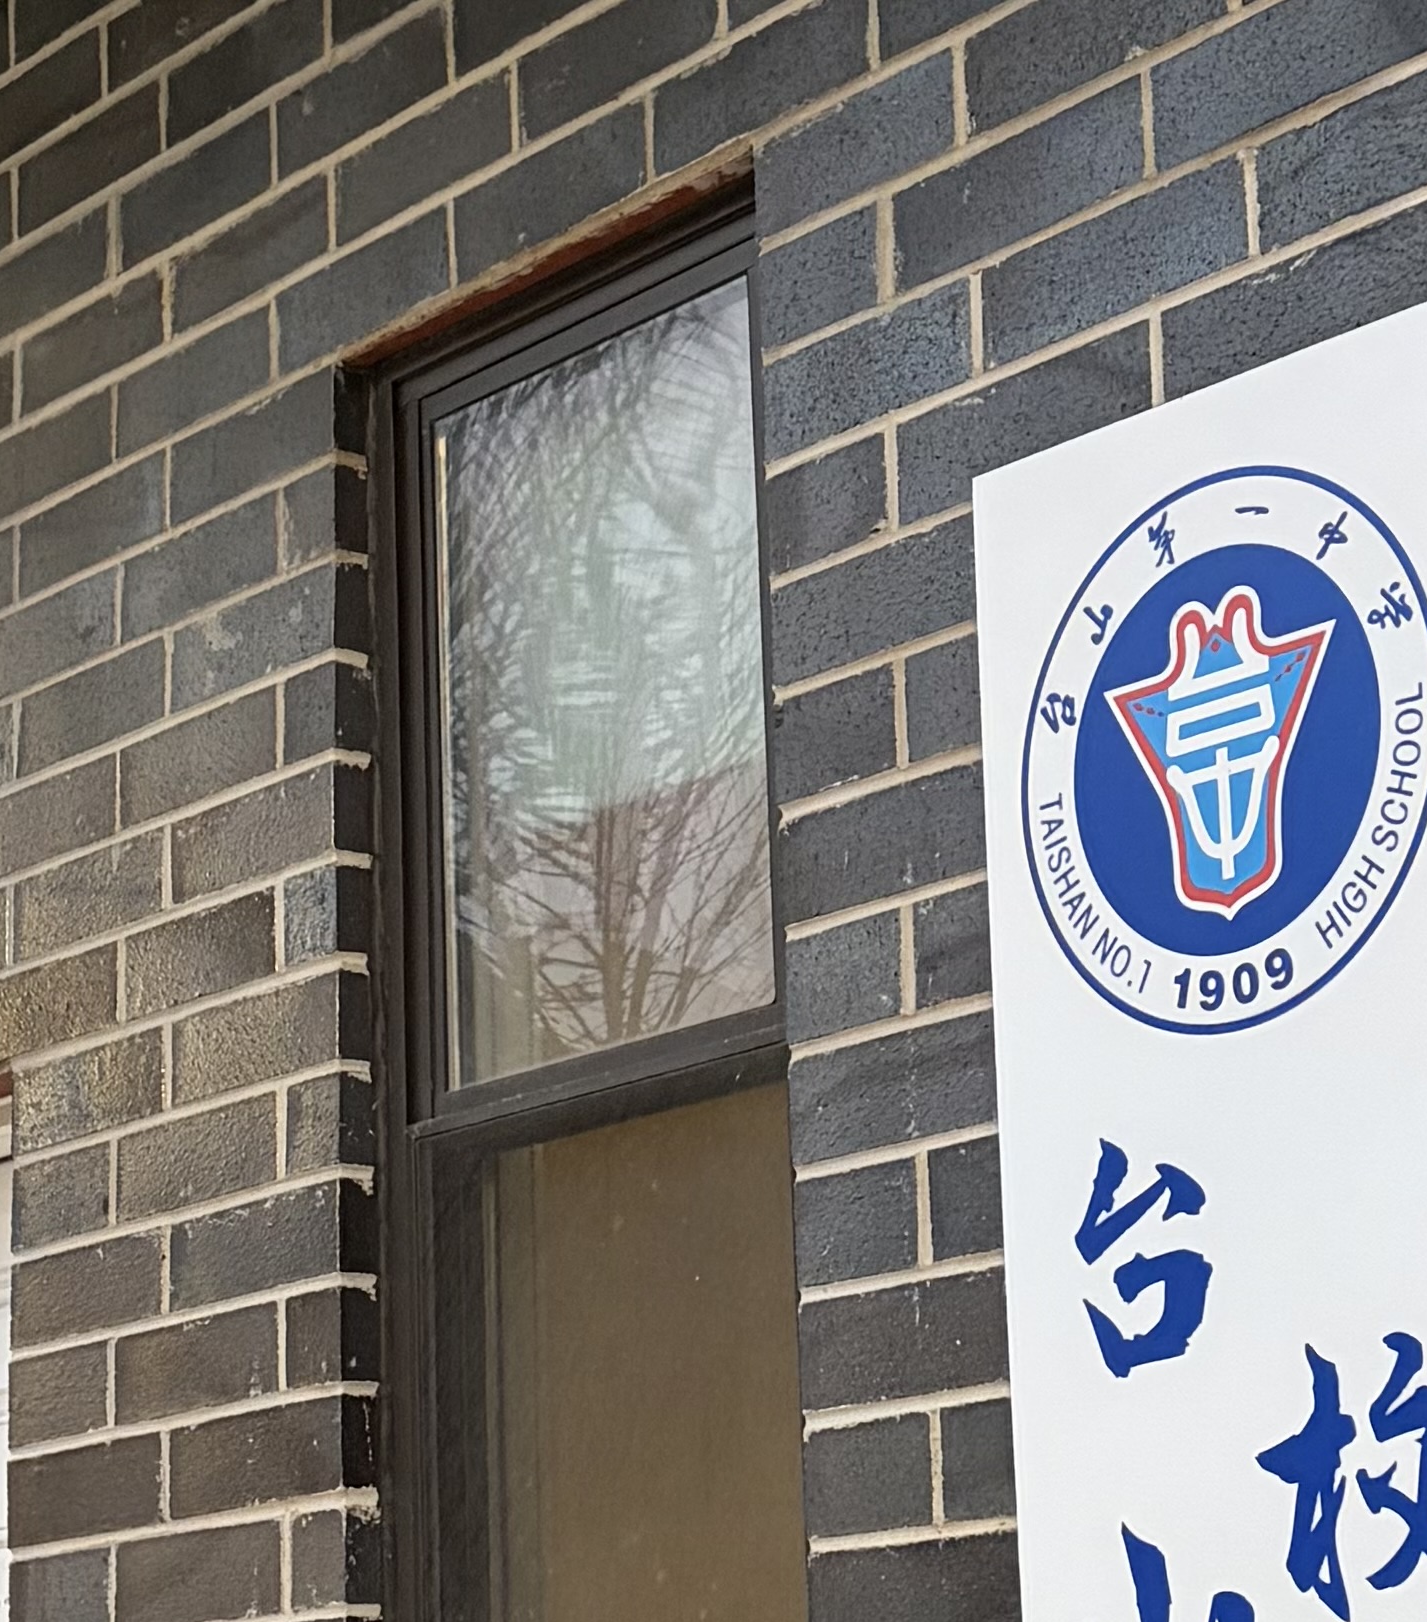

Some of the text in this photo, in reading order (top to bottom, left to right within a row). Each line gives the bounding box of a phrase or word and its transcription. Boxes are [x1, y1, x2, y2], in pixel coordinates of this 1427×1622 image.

[1038, 681, 1424, 994] TAISHAN NO.1 HIGH SCHOOL
[1173, 948, 1294, 1011] 1909
